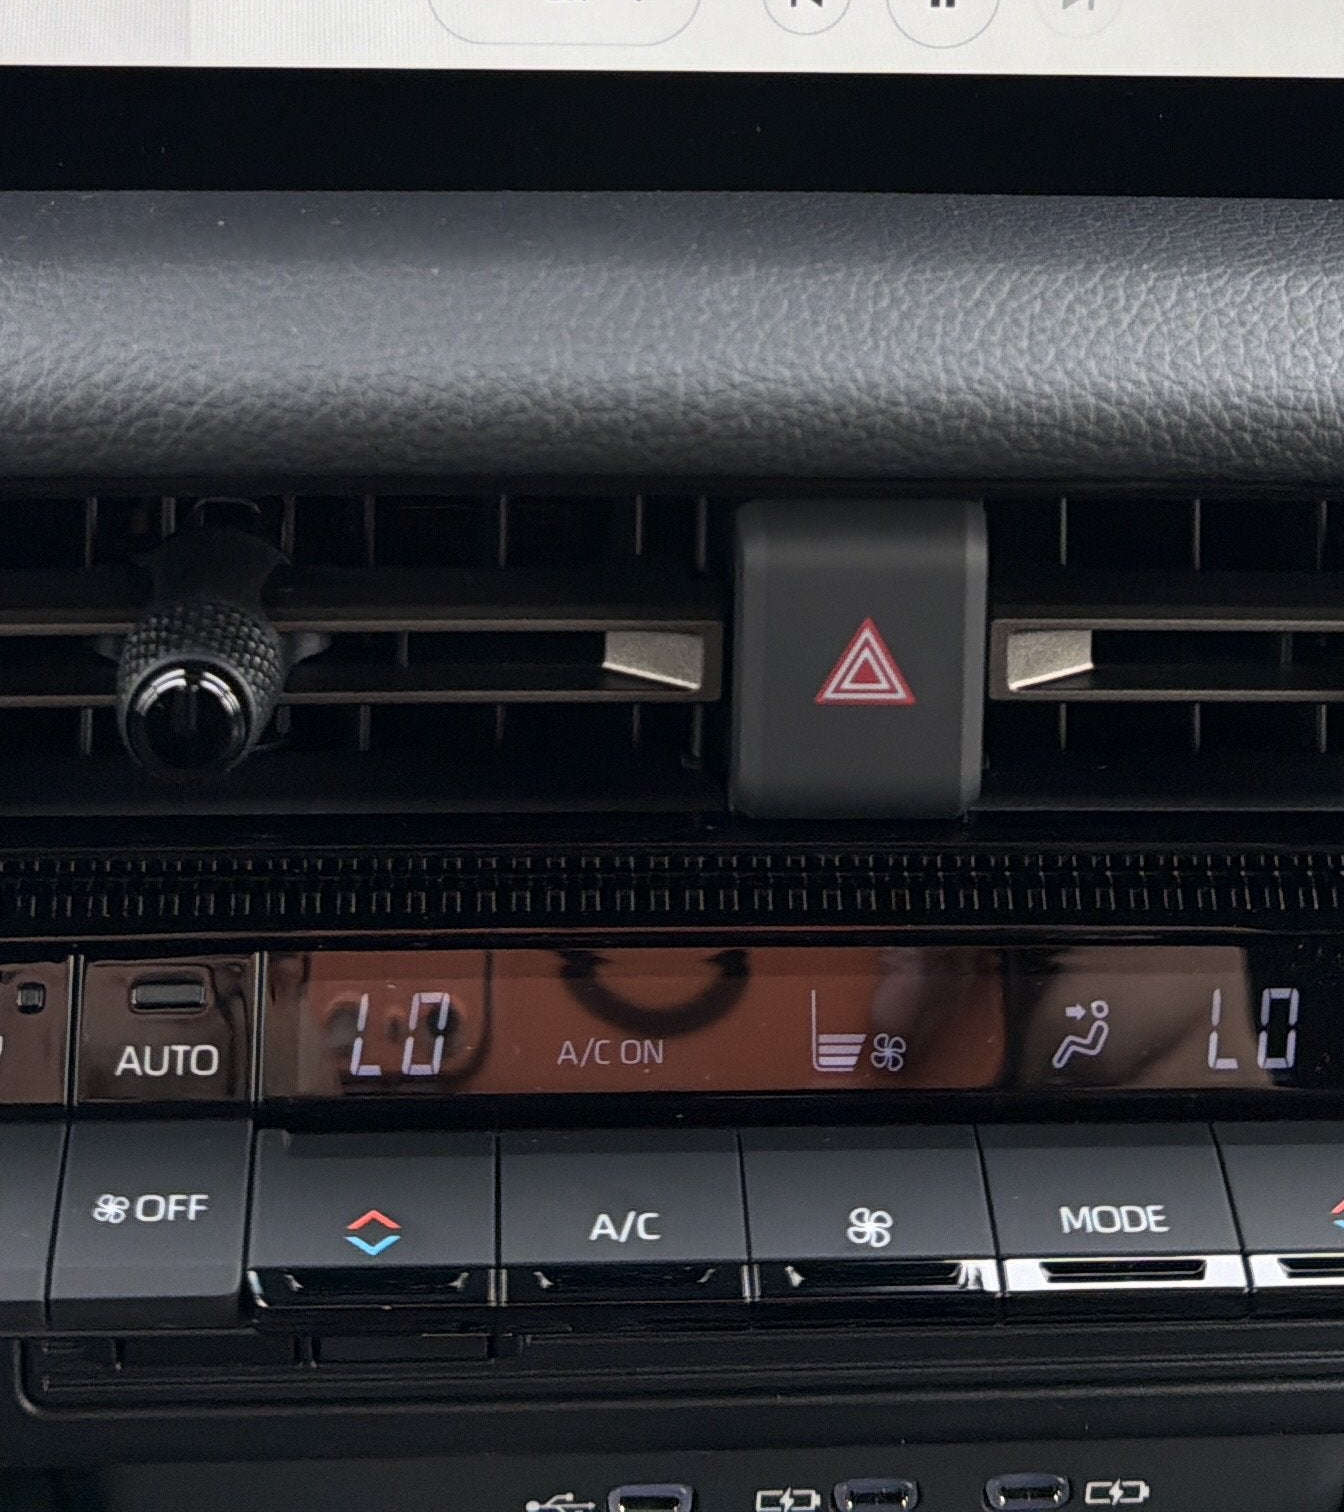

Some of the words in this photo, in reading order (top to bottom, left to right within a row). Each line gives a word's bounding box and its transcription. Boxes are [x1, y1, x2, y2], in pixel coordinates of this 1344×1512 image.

[114, 1044, 219, 1077] AUTO
[556, 1037, 611, 1068] A/C
[620, 1039, 664, 1065] ON
[135, 1194, 209, 1222] OFF
[1059, 1204, 1170, 1234] MODE
[588, 1210, 661, 1243] A/C
